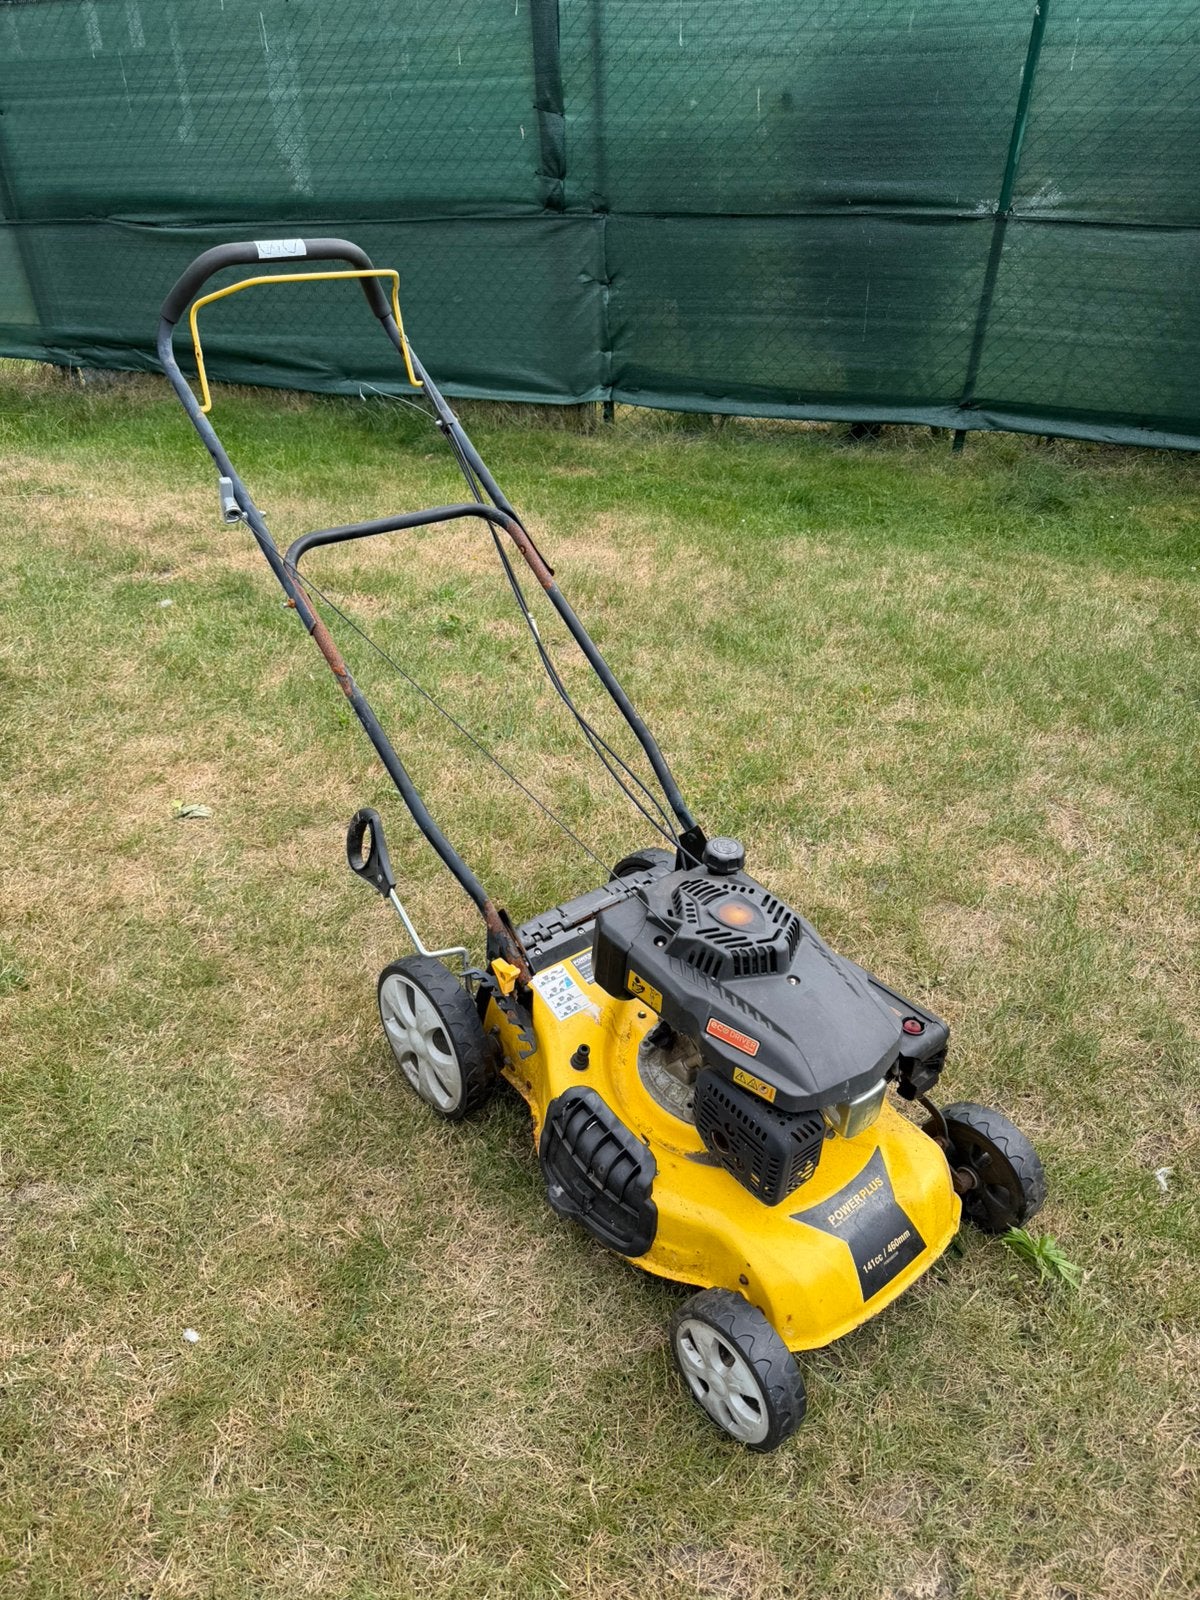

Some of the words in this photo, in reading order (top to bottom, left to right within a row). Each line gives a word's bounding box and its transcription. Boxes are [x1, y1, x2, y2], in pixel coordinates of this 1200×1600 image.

[729, 1032, 757, 1050] DRIVER
[862, 1253, 884, 1274] 141cc
[887, 1230, 911, 1253] 460mm
